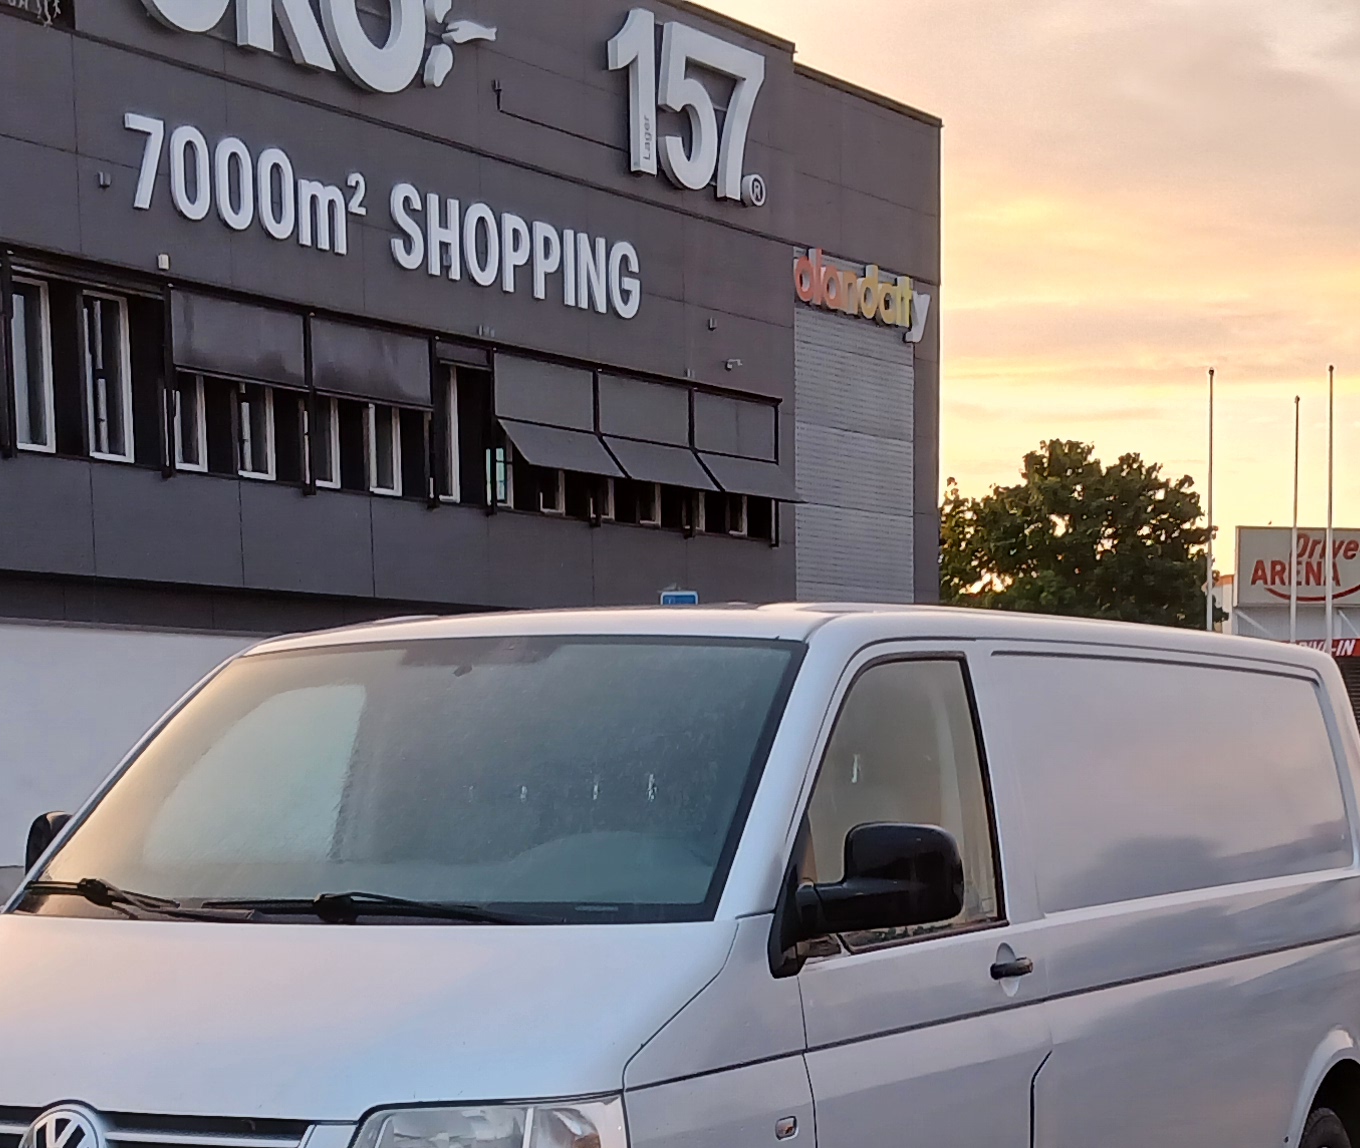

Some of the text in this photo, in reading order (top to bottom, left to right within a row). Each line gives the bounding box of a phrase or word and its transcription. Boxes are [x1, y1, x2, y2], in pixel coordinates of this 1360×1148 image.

[607, 8, 765, 202] 157
[643, 115, 652, 160] Lager
[390, 183, 641, 319] SHOPPING
[1250, 559, 1341, 586] ARENA
